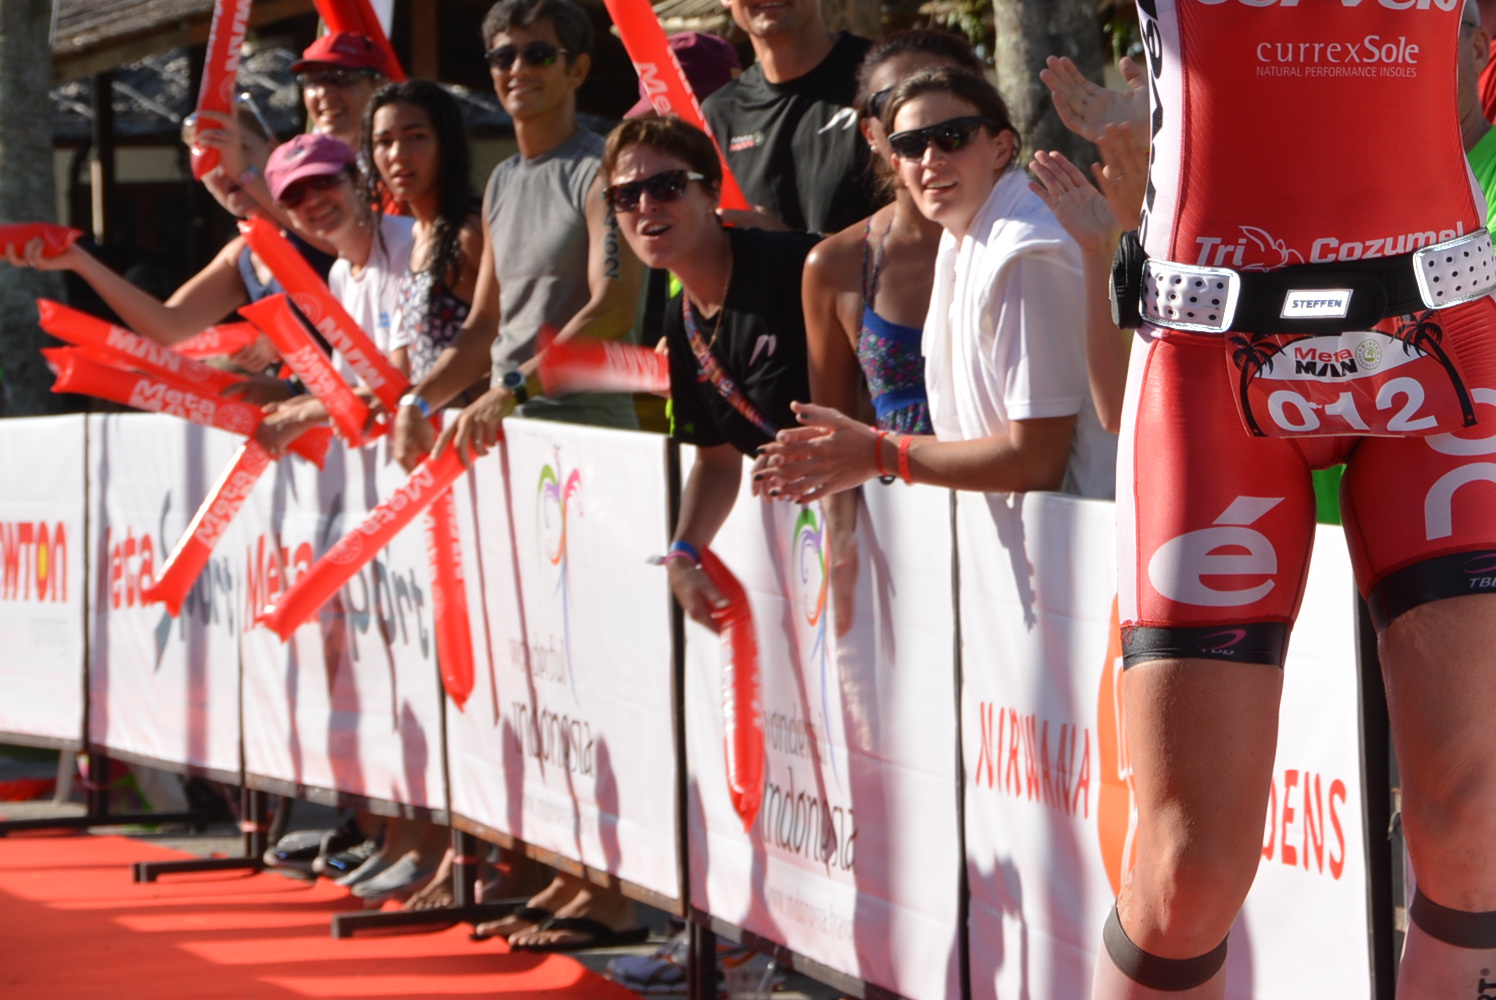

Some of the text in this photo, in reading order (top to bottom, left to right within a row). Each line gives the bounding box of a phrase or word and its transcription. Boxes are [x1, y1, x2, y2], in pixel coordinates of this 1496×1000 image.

[1256, 34, 1420, 65] currexSole
[1256, 66, 1417, 78] NATURAL PERFORMANCE INSOLES
[1195, 236, 1247, 267] Tri
[1291, 299, 1342, 309] STEFFEN
[106, 324, 183, 372] MAN
[1294, 347, 1354, 363] Meta
[1295, 358, 1359, 378] MAN
[134, 379, 216, 417] Meta
[1267, 376, 1439, 432] 012
[1147, 495, 1287, 608] é
[975, 700, 1091, 821] NIRWANA
[1261, 768, 1348, 881] DENS
